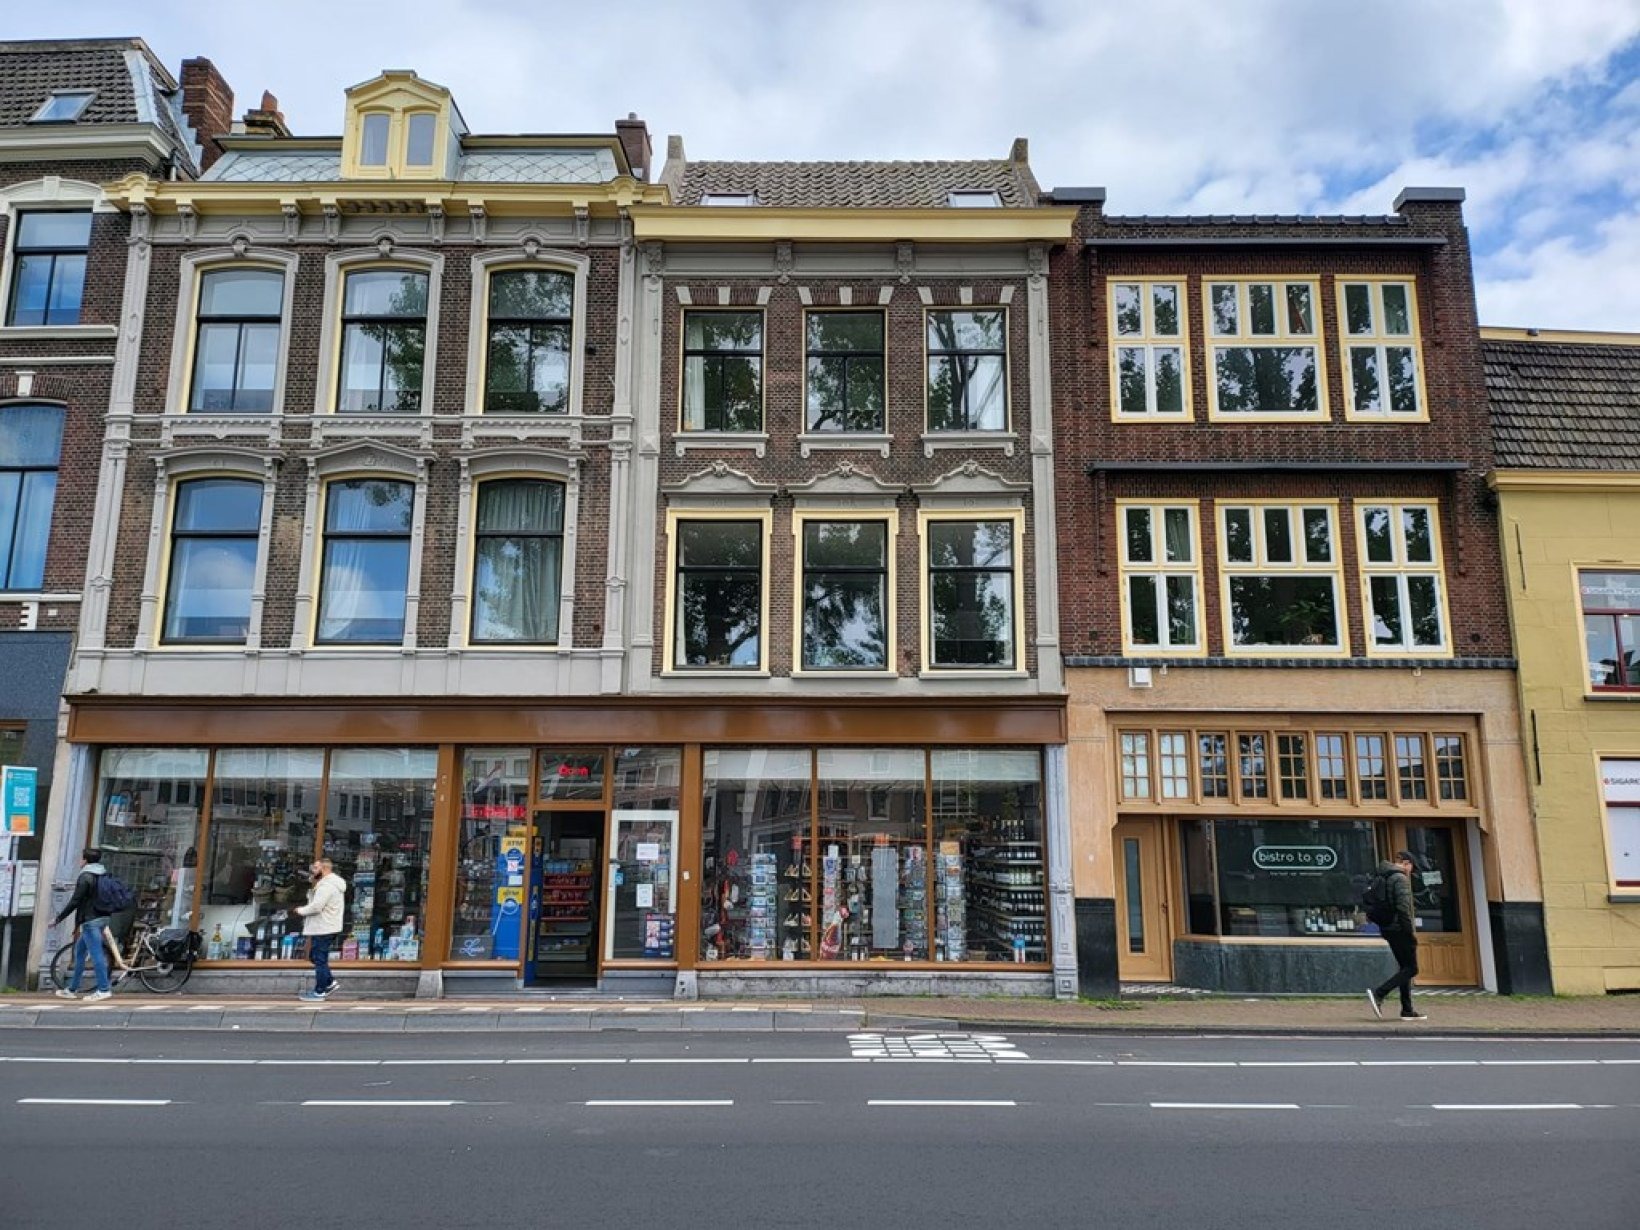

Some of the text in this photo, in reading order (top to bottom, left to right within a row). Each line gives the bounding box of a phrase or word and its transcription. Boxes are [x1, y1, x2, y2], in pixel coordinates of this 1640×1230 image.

[1258, 851, 1332, 866] bistro to go
